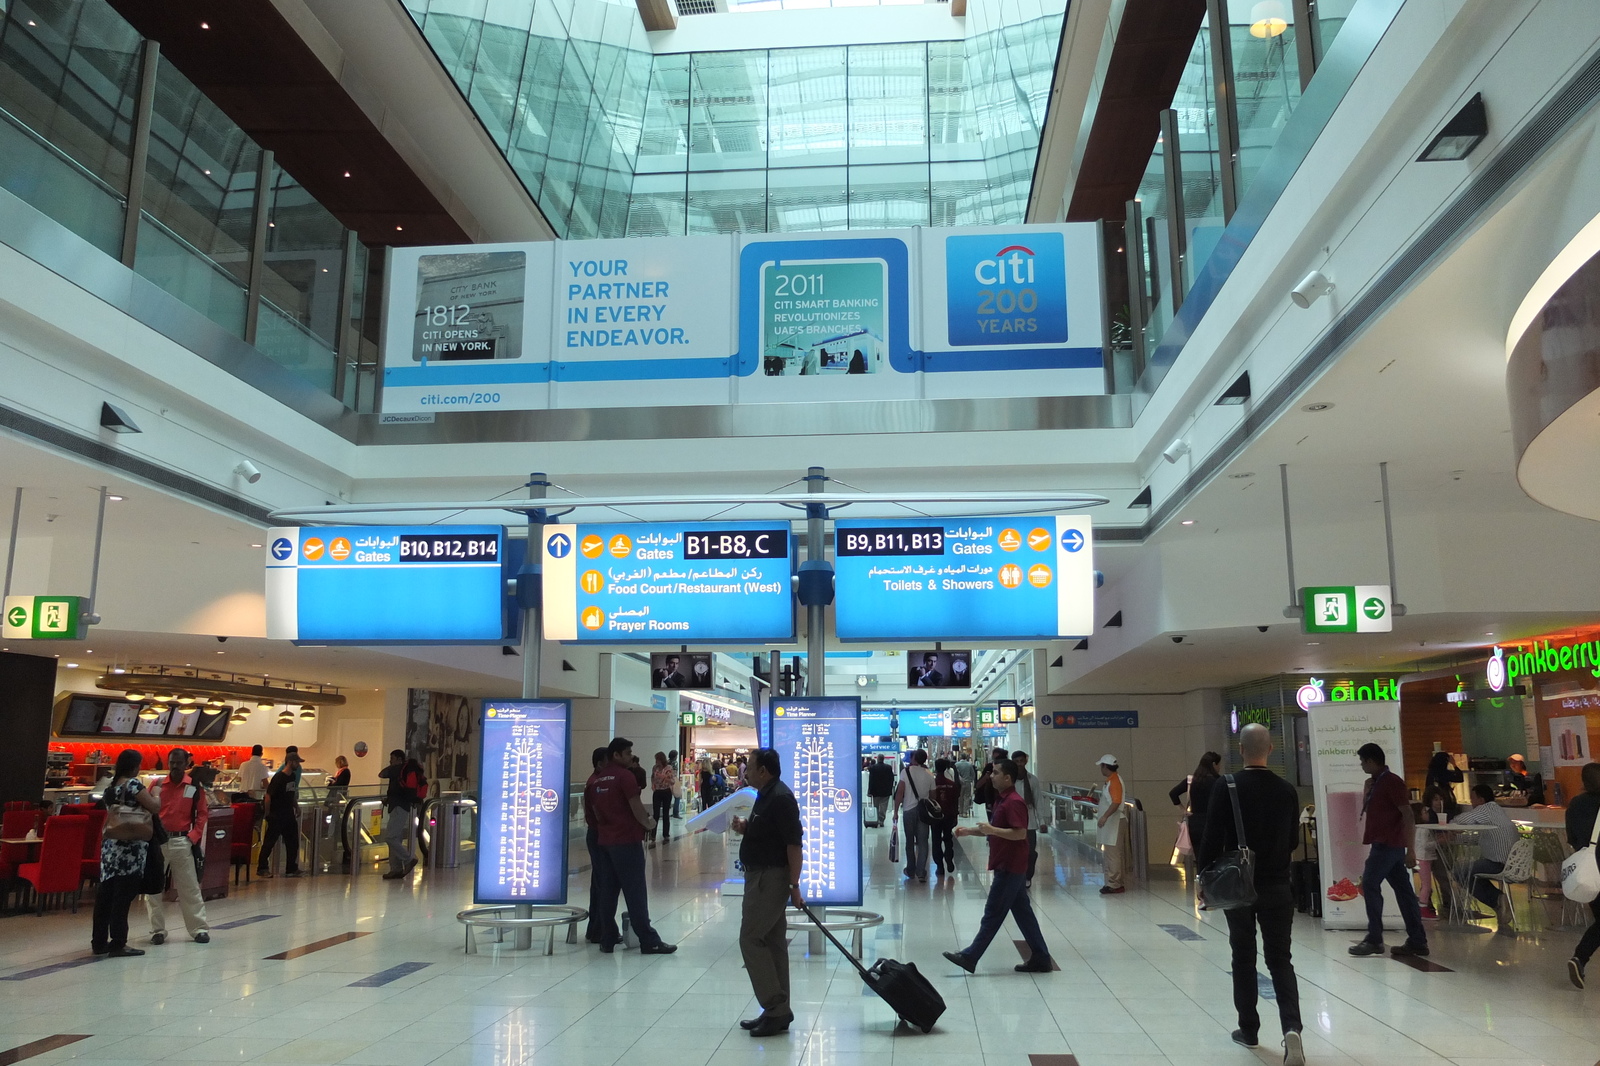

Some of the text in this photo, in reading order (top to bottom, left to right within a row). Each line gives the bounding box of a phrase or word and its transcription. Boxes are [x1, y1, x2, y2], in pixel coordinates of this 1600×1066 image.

[568, 259, 628, 277] YOUR
[974, 245, 1035, 285] citi
[450, 281, 497, 294] CITY BANK
[568, 281, 669, 301] PARTNER
[774, 274, 824, 296] 2011
[774, 298, 879, 310] CITI SMART BANKING
[977, 288, 1037, 315] 200
[424, 304, 470, 326] 1812
[568, 305, 667, 324] IN EVERY
[774, 310, 861, 322] REVOLUTIONIZES
[774, 323, 864, 335] UAE'S BRANCHES.
[977, 318, 1037, 334] YEARS
[423, 330, 478, 340] CITI OPENS
[567, 328, 690, 348] ENDEAVOR.
[422, 341, 491, 352] IN NEW YORK.
[420, 393, 501, 405] citi.com/200
[382, 415, 432, 423] JCDecauxDicon
[636, 532, 683, 546] البوابات
[944, 526, 993, 541] البوابات
[355, 535, 399, 548] البوابات
[687, 535, 769, 557] B1-B8, C
[846, 533, 942, 552] B9, B11, B13
[400, 540, 497, 558] B10, B12, B14
[636, 548, 674, 560] Gates
[952, 542, 993, 555] Gates
[355, 551, 391, 562] Gates
[741, 567, 763, 579] ركن
[967, 564, 993, 575] دورات
[608, 583, 637, 594] Food
[744, 581, 781, 595] (West)
[883, 579, 994, 591] Toilets & Showers
[609, 620, 690, 632] Prayer Rooms
[1507, 639, 1600, 687] pinkberry
[1127, 717, 1134, 725] G
[1317, 748, 1358, 757] pinkberry
